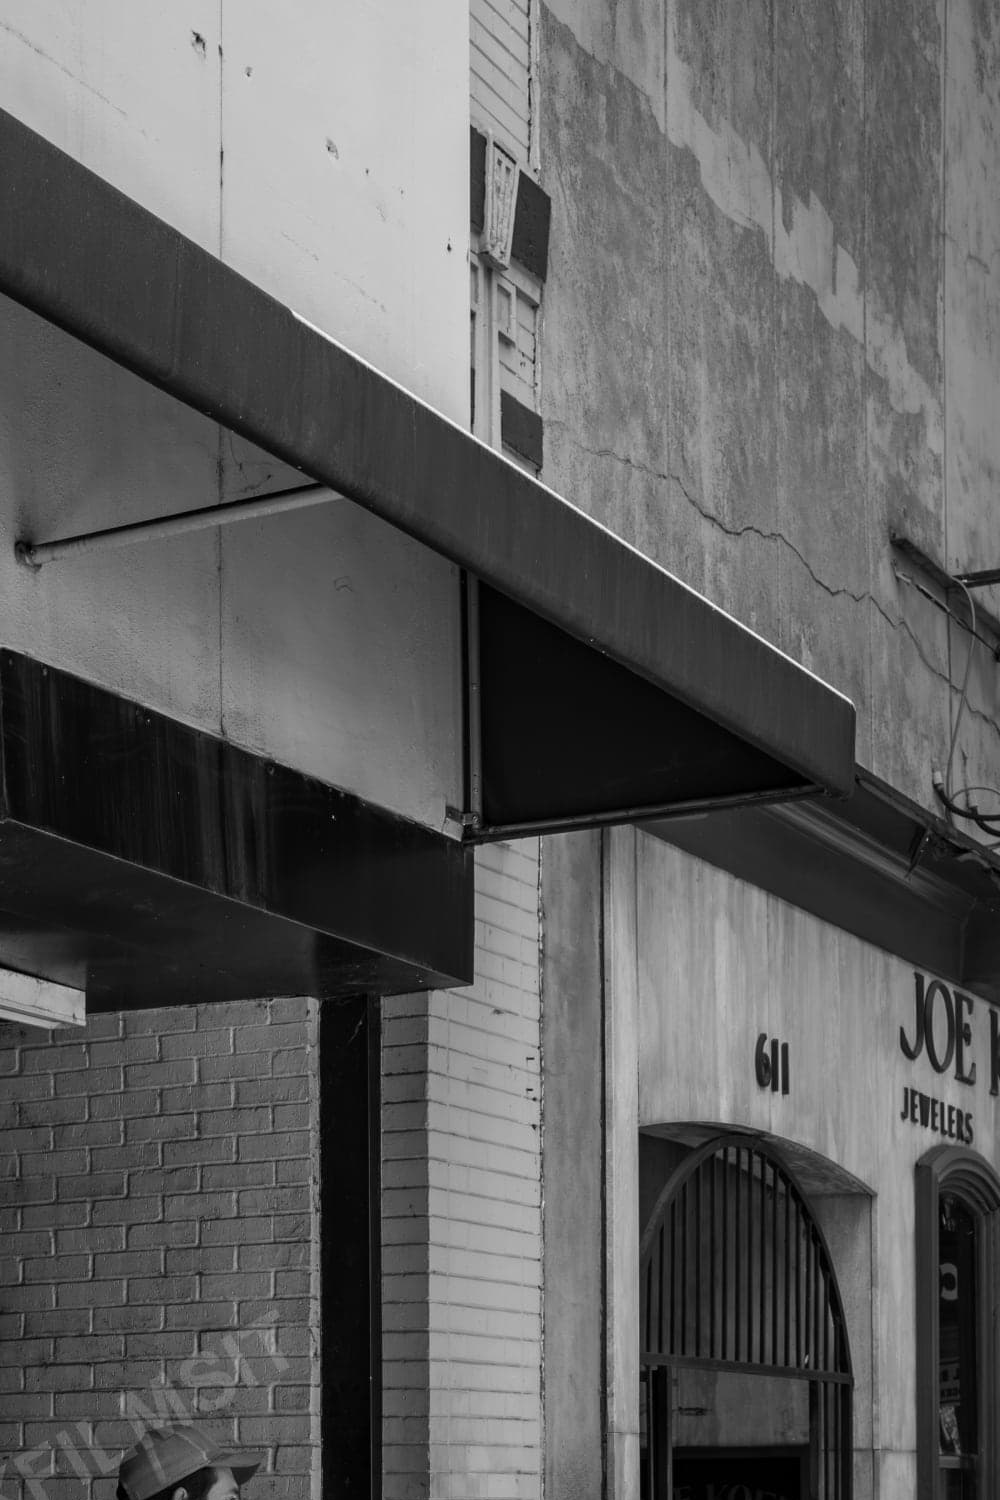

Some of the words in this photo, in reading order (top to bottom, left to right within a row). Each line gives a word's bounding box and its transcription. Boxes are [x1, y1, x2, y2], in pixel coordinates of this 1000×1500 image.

[900, 971, 976, 1086] JOE
[755, 1033, 790, 1095] 611
[900, 1086, 973, 1145] JEWELERS
